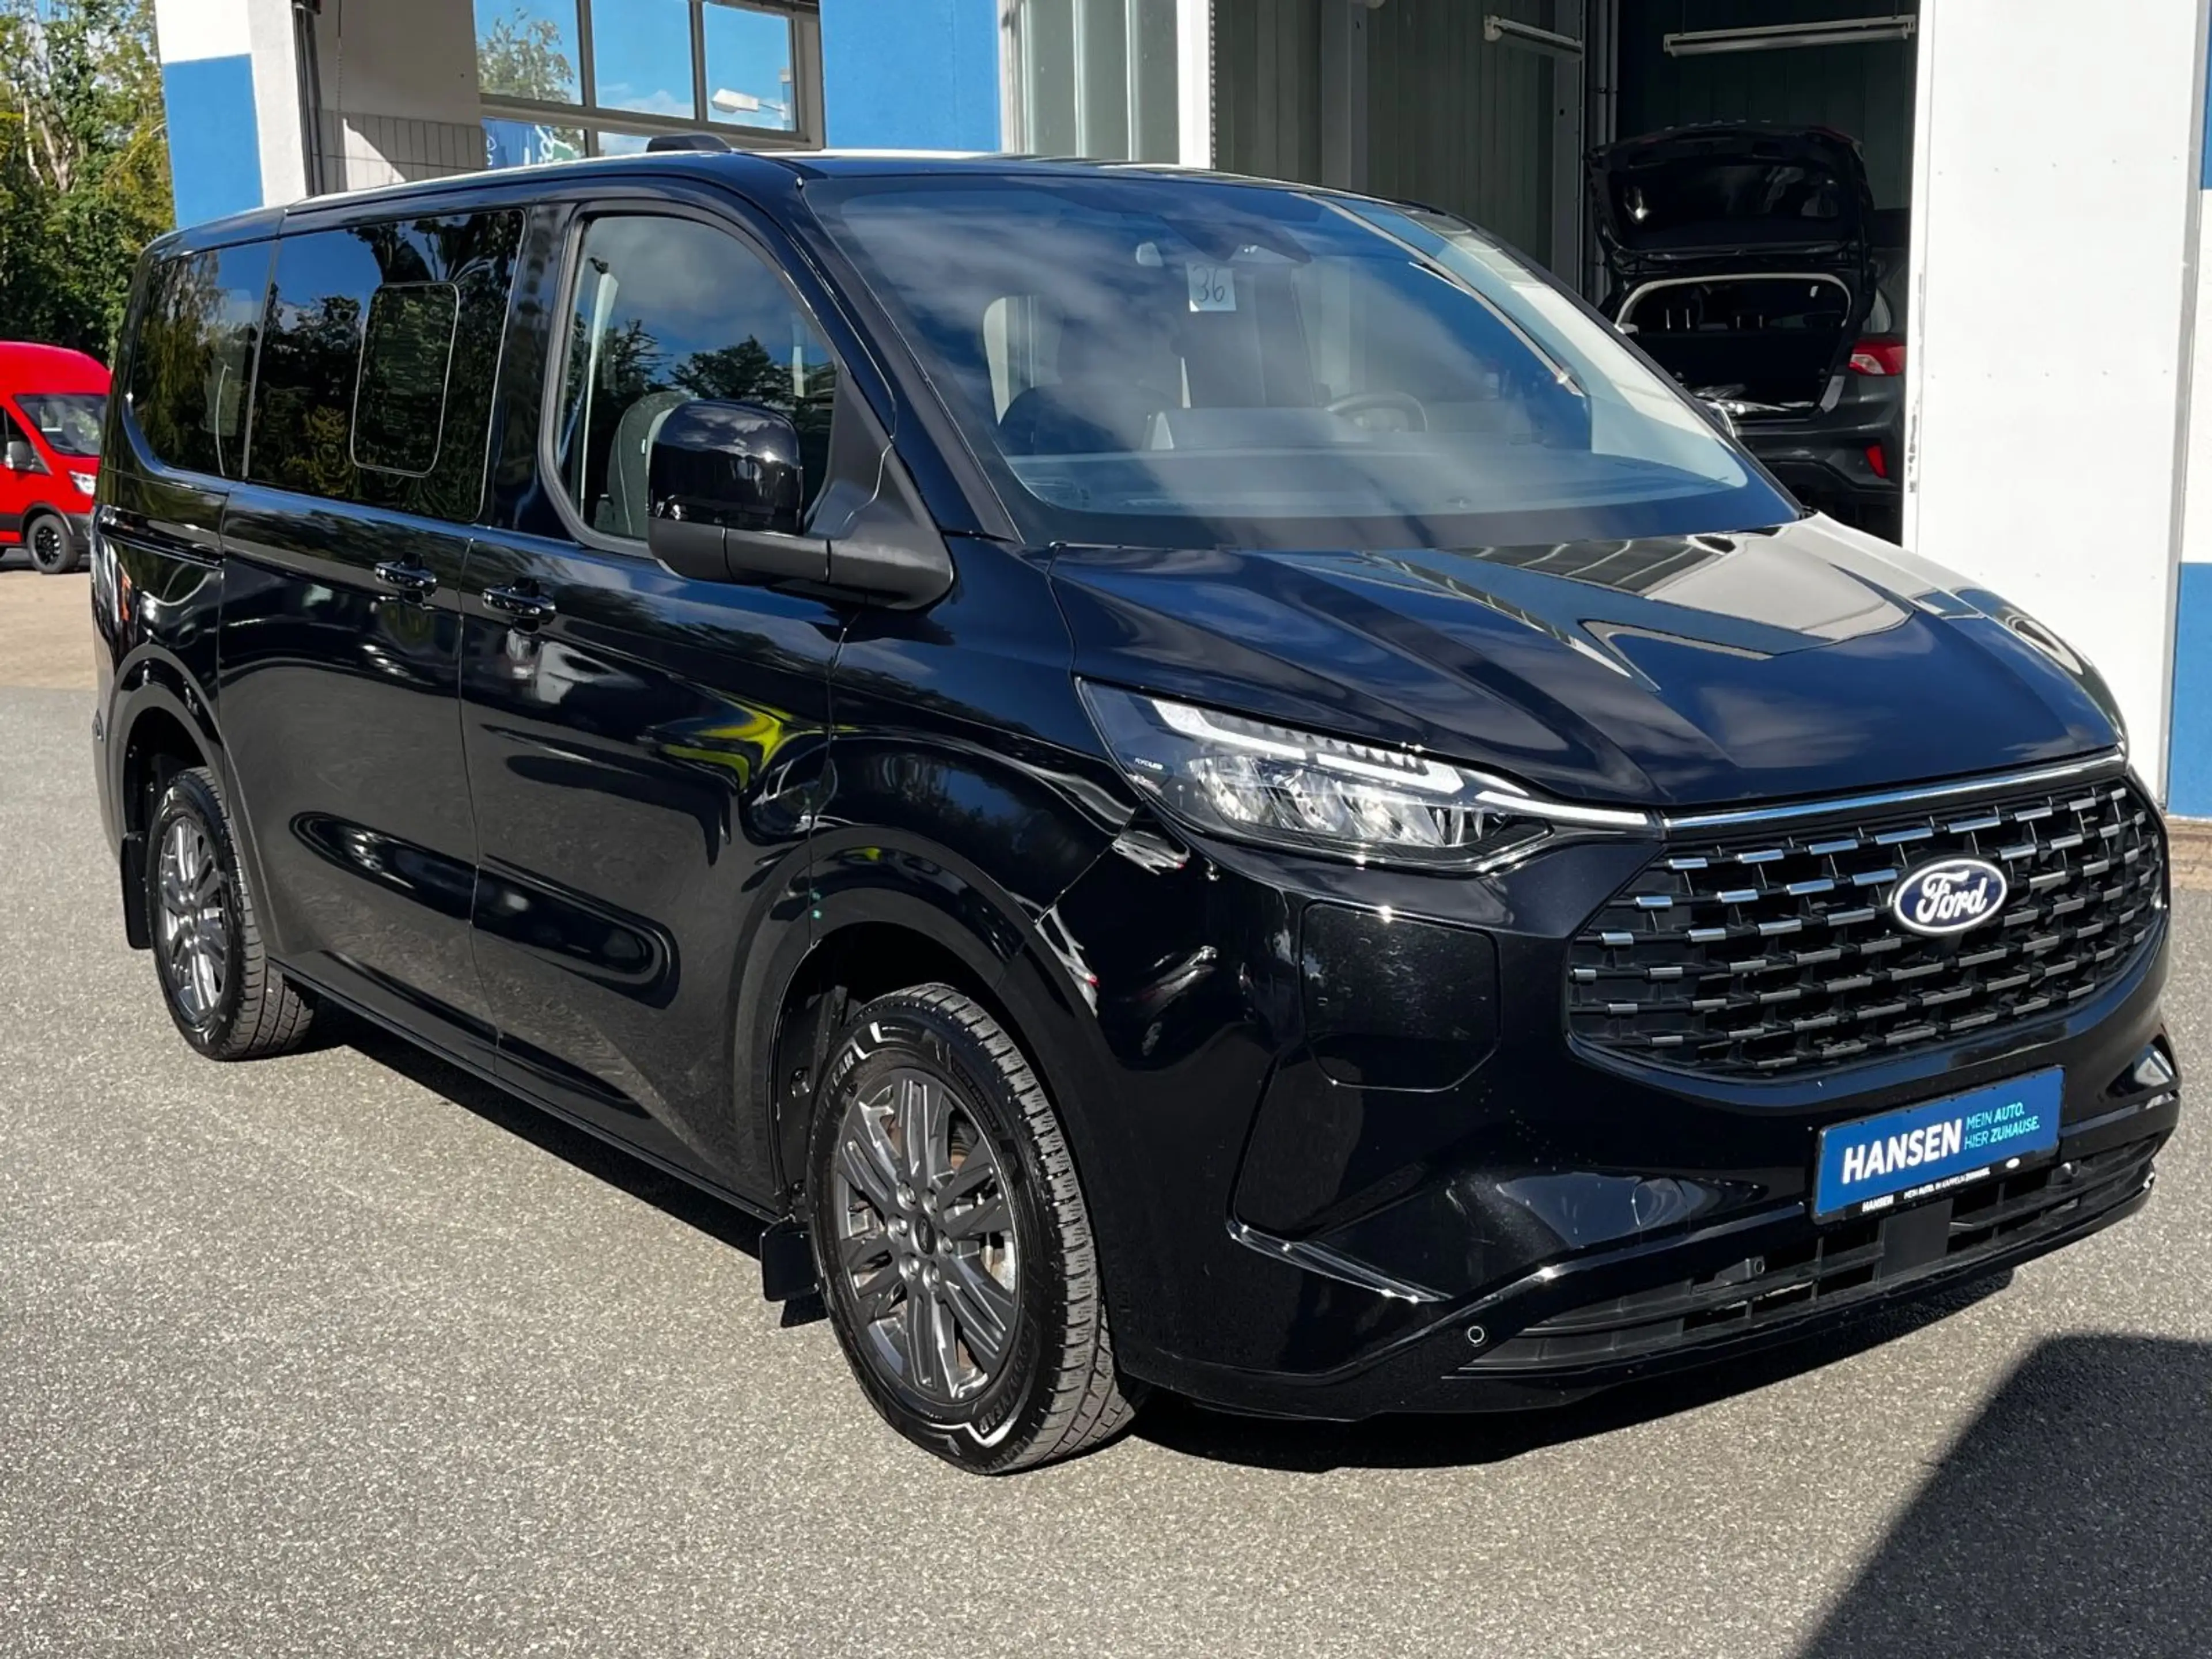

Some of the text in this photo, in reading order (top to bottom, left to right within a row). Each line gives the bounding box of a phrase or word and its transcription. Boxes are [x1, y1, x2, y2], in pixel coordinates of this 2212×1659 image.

[1193, 264, 1225, 302] 36
[1916, 869, 1987, 923] Ford
[1964, 1115, 2040, 1150] HIER ZUHAUSE.
[1965, 1102, 2025, 1131] MEIN AUTO.
[1842, 1119, 1962, 1184] HANSEN
[1862, 1195, 1894, 1212] HANSEN
